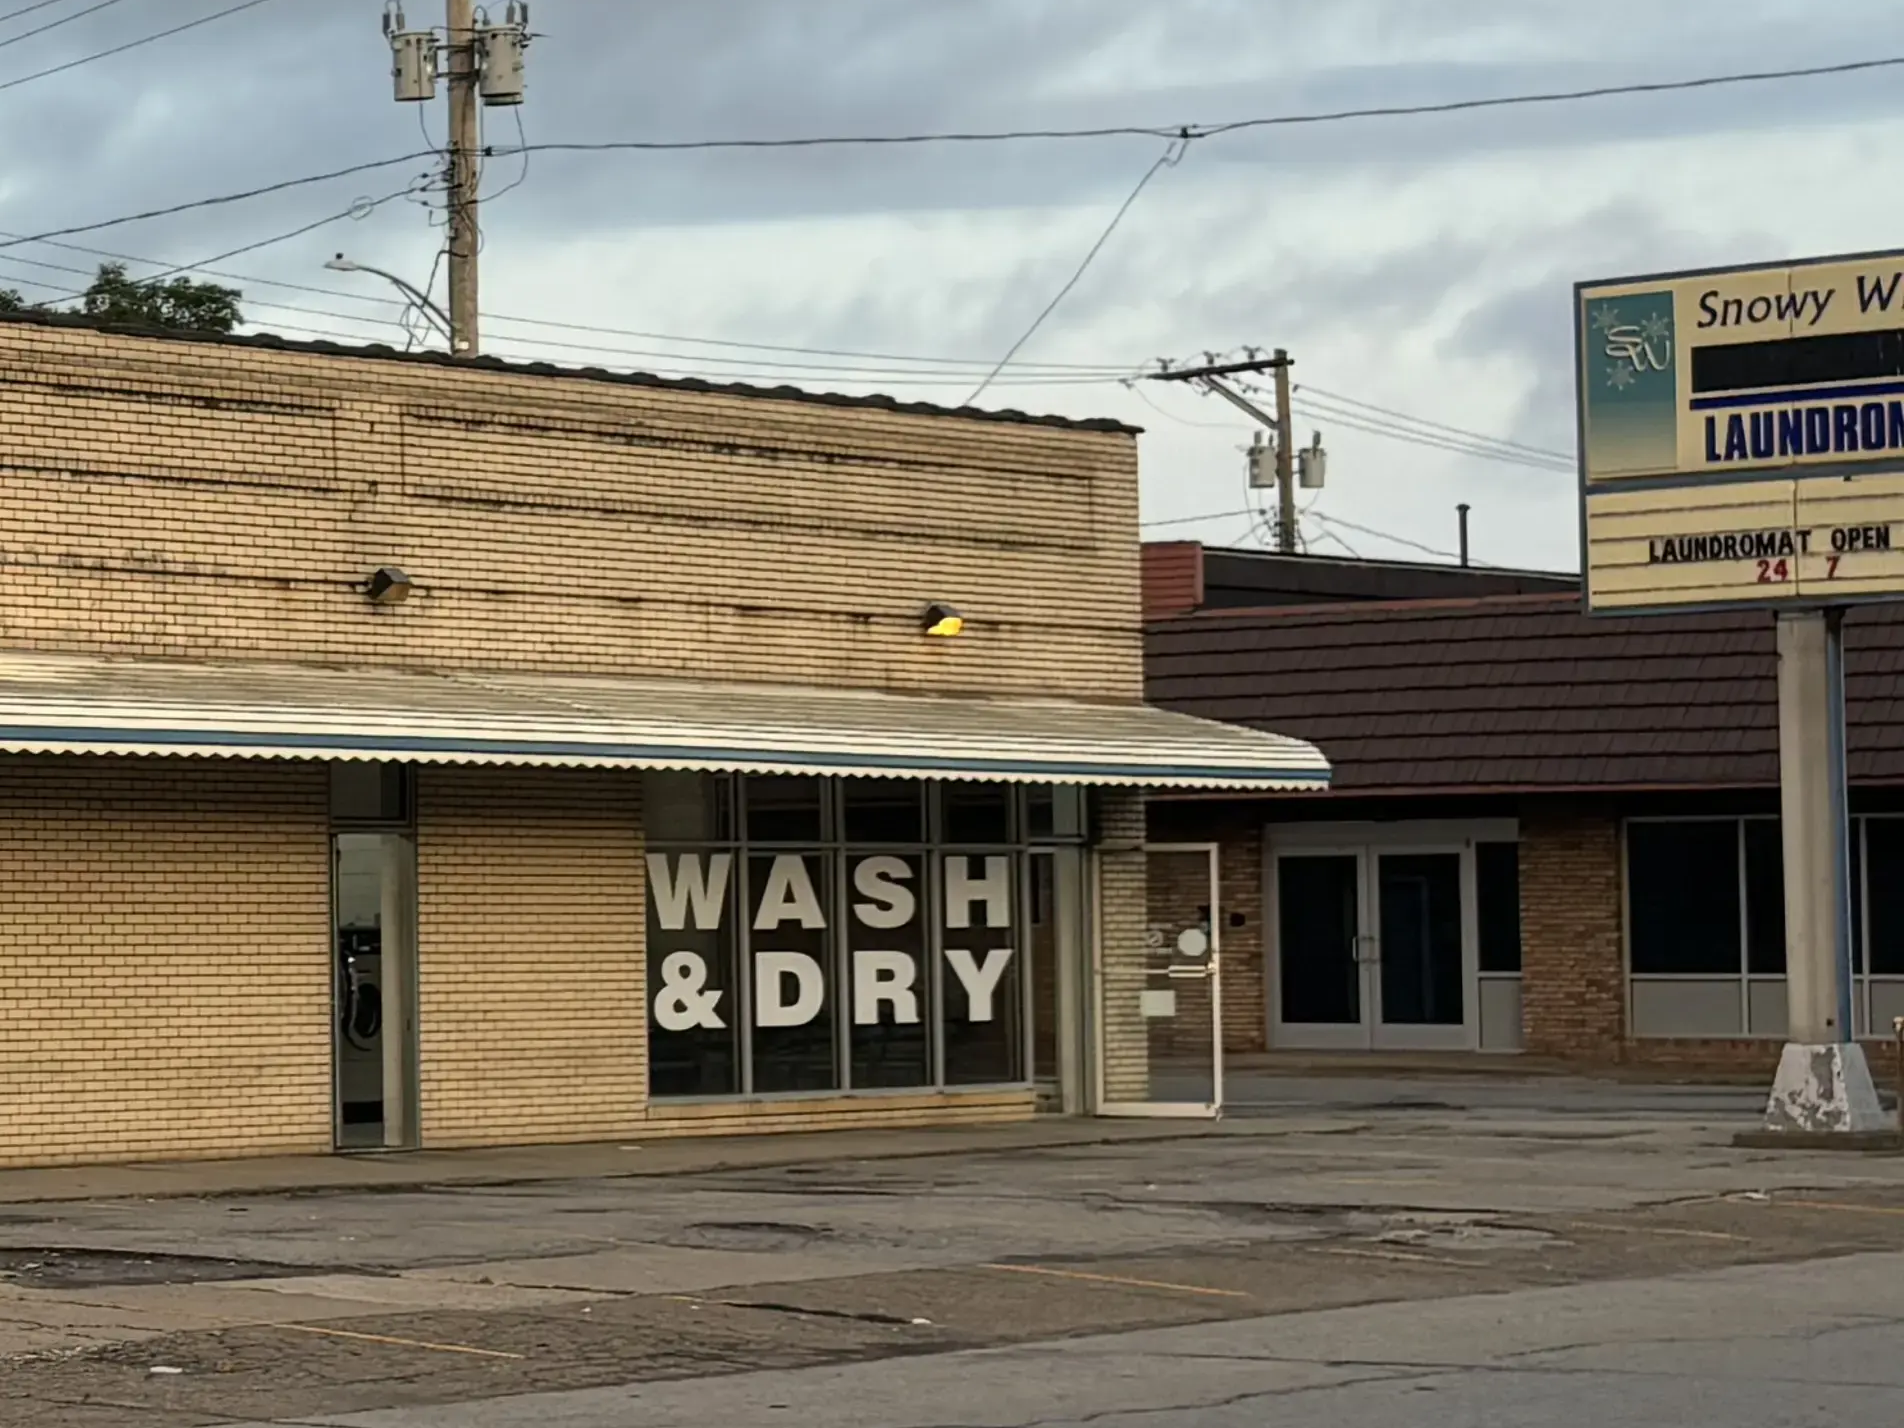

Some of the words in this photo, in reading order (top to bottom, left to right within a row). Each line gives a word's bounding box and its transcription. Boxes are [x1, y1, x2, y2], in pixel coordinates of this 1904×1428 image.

[1696, 288, 1836, 329] Snowy
[1856, 271, 1904, 315] W
[1648, 529, 1812, 564] LAUNDROMAT
[1830, 524, 1891, 552] OPEN
[1756, 558, 1789, 583] 24
[1825, 555, 1840, 581] 7
[645, 852, 1011, 932] WASH
[653, 950, 727, 1031] &
[755, 948, 1014, 1028] DRY
